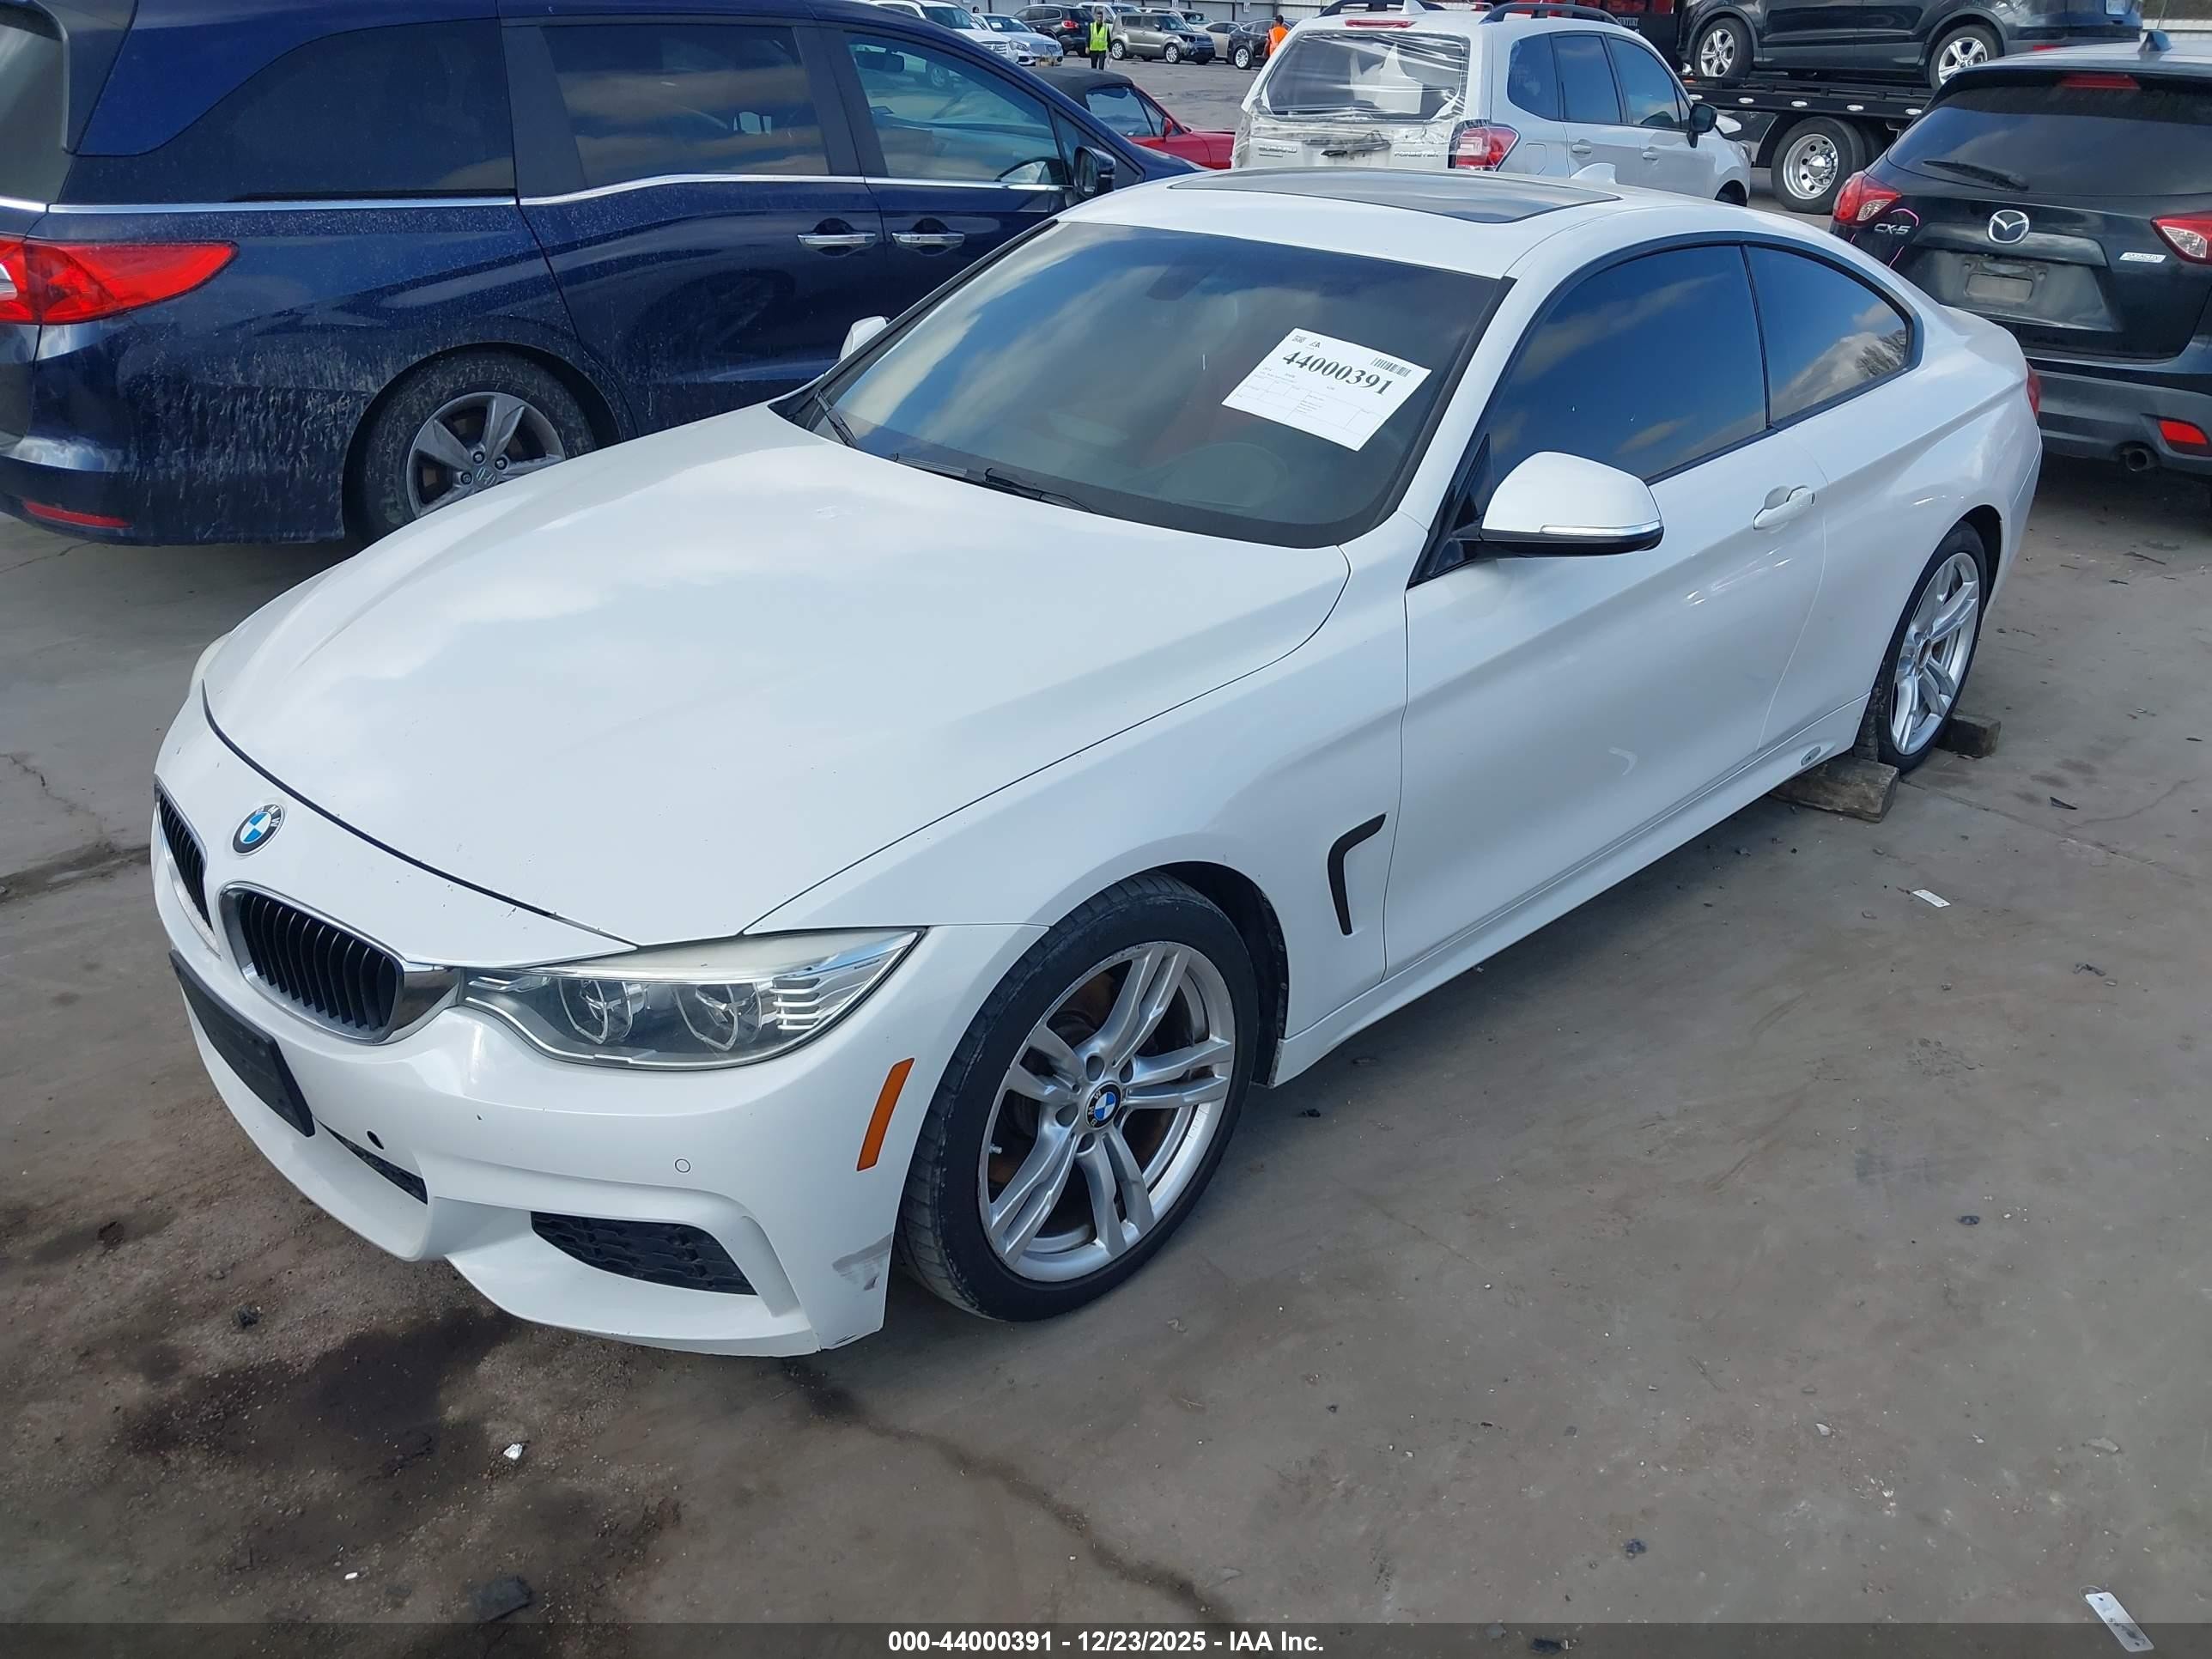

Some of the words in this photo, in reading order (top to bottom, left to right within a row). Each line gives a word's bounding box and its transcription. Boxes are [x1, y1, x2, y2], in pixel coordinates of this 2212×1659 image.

[1258, 145, 1297, 154] SUBARU
[1875, 223, 1911, 234] CX-5
[1282, 350, 1394, 396] 44000391
